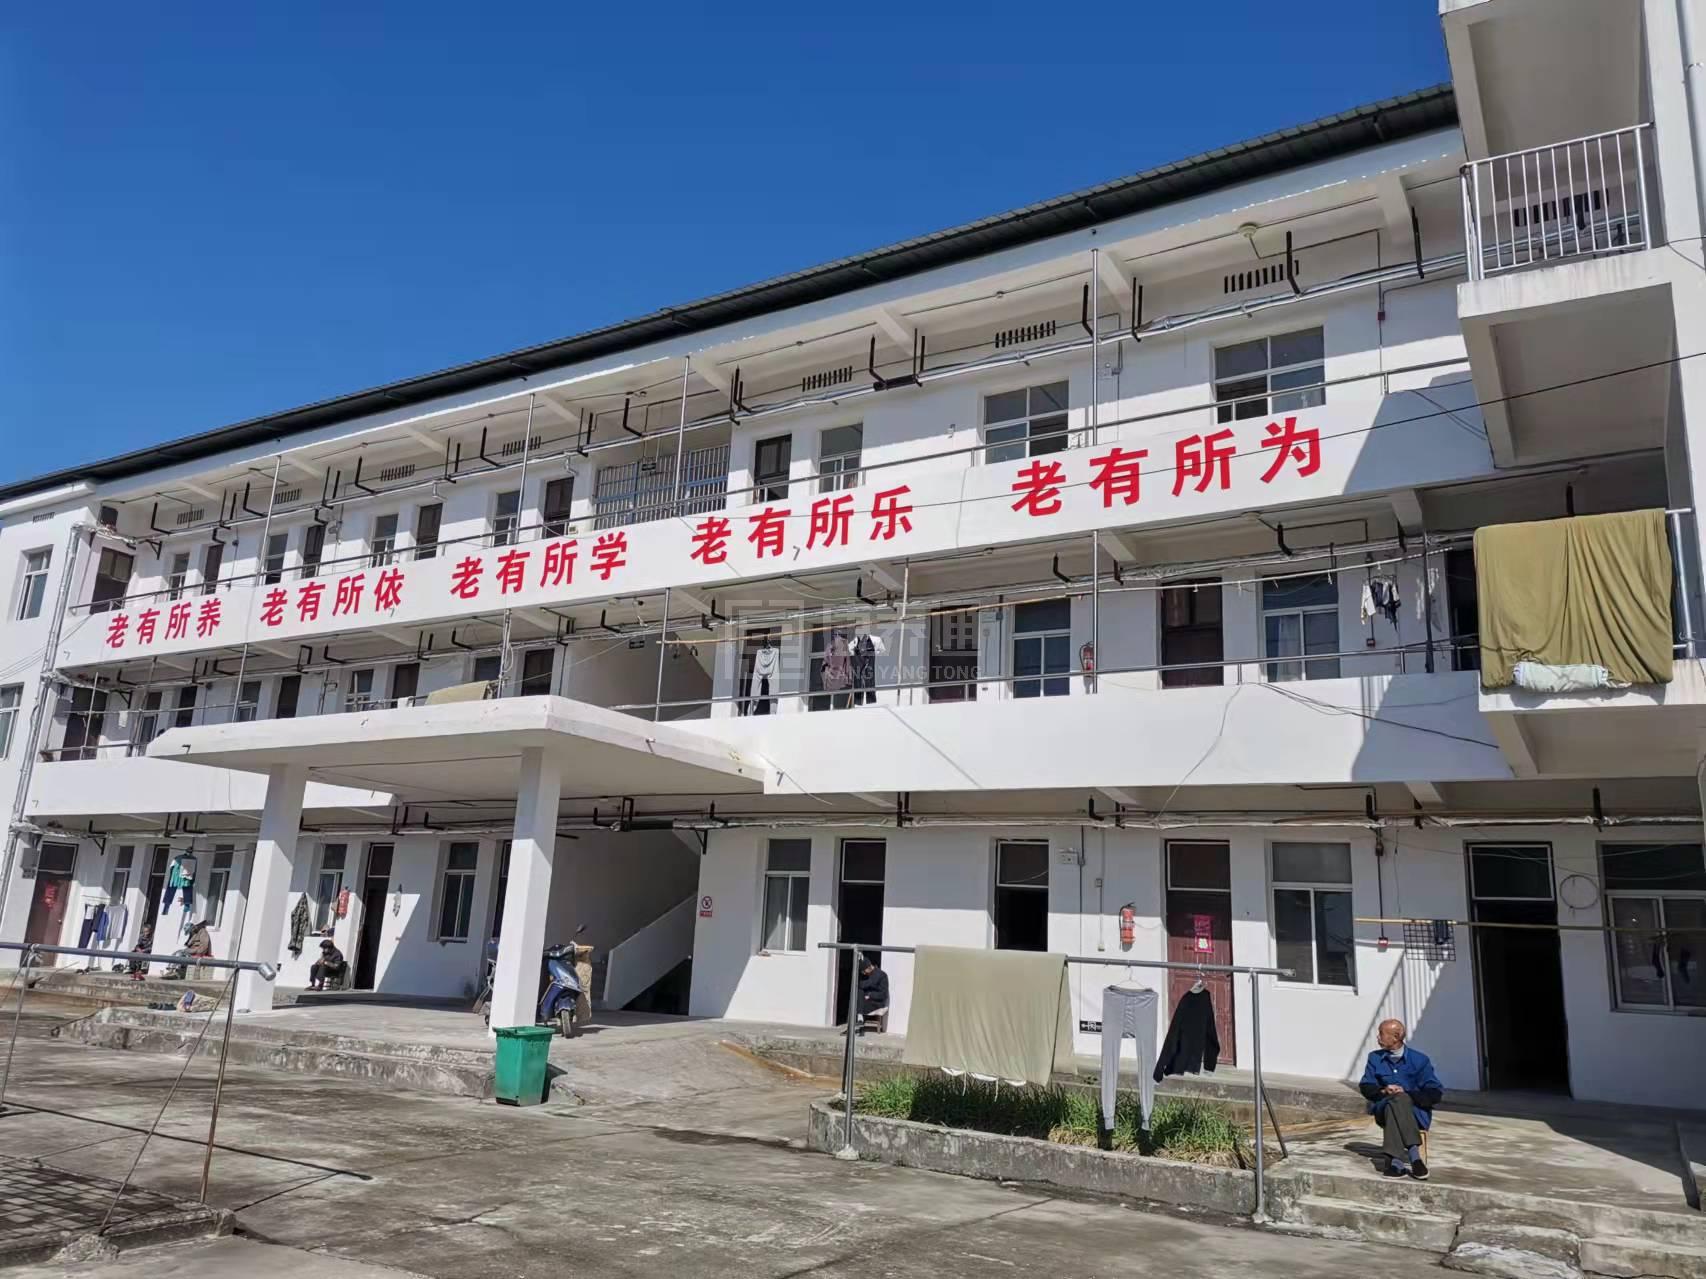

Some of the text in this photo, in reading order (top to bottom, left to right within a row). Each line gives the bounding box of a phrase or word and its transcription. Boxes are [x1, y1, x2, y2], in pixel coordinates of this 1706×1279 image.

[106, 416, 1322, 649] 老有所养 老有所依 老有所学 老有所乐 老有所为
